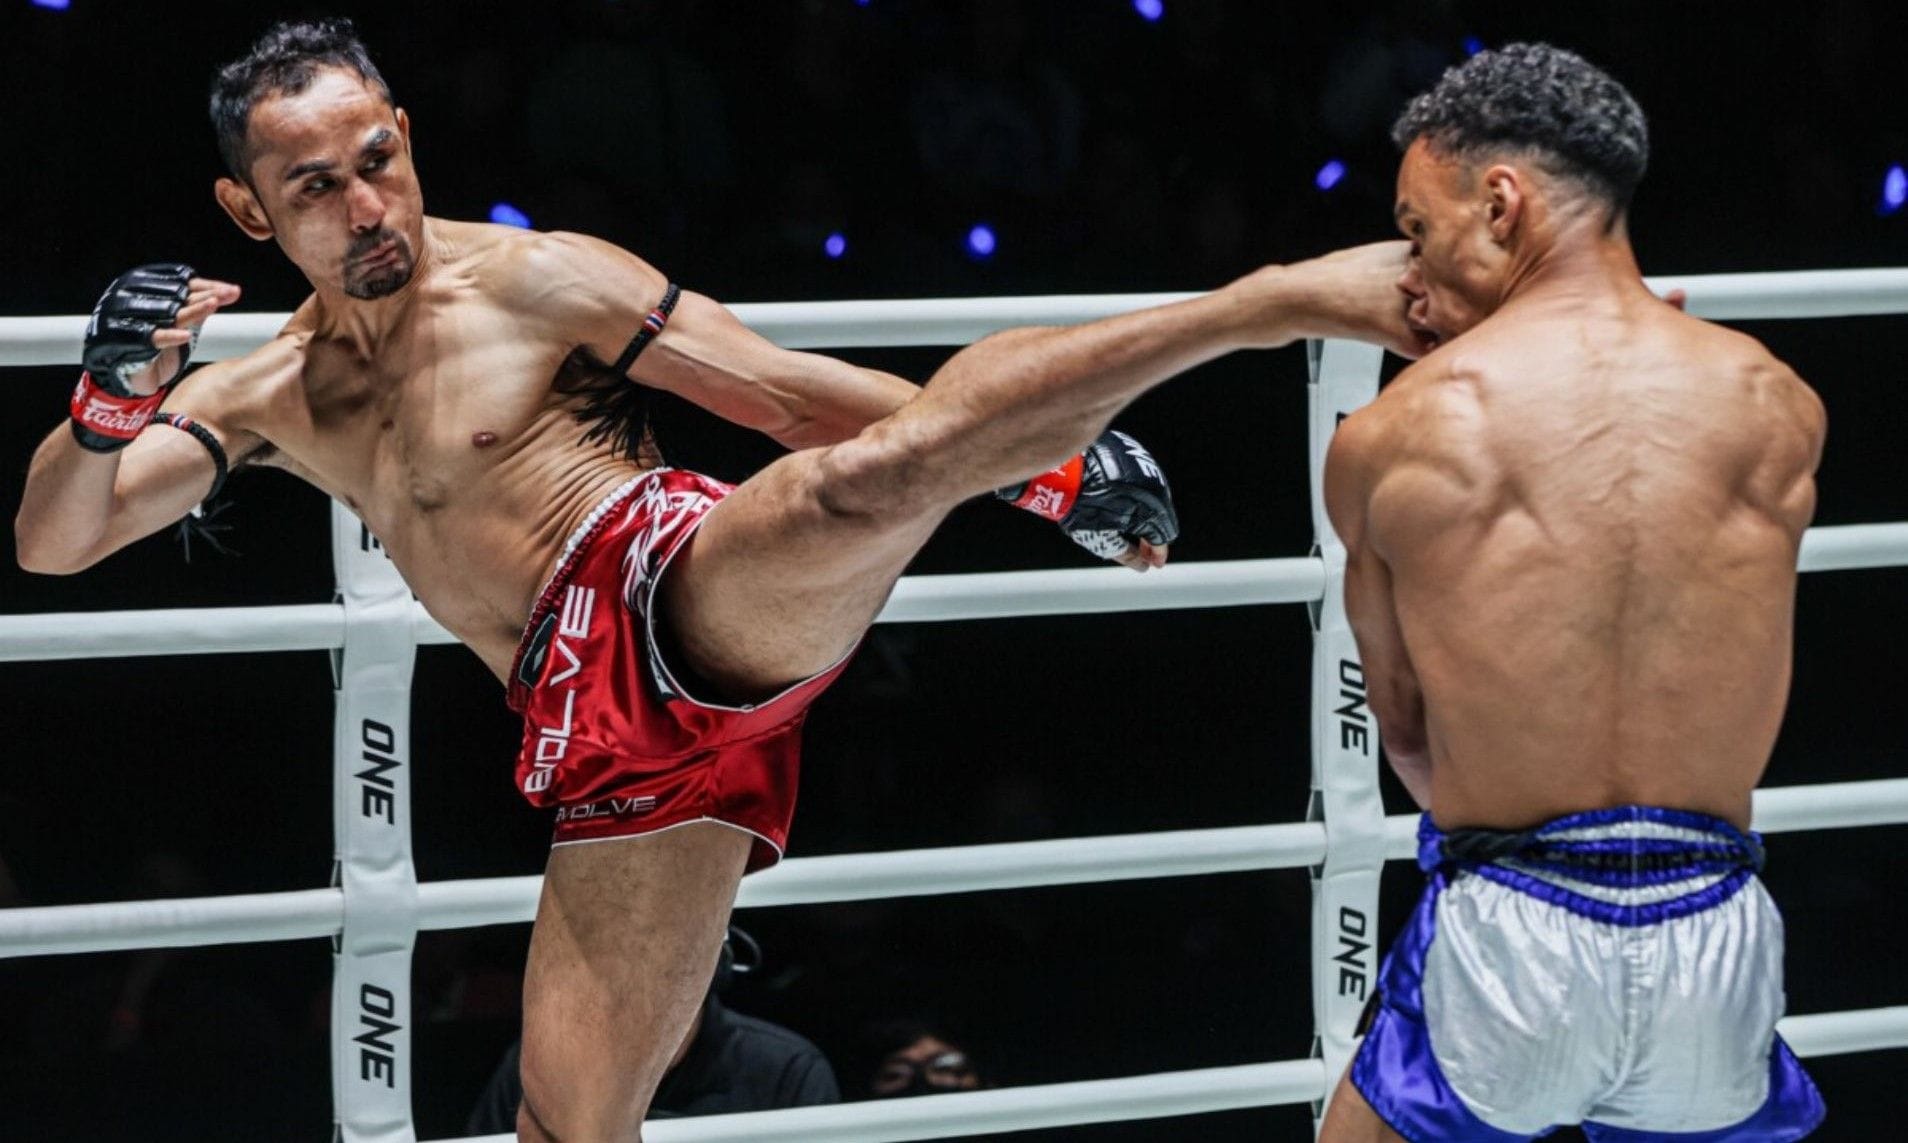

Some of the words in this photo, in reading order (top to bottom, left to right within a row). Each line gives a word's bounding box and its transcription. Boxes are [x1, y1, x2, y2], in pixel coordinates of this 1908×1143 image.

[524, 584, 596, 794] EOLVE
[1333, 658, 1369, 758] ONE
[352, 718, 403, 826] ONE
[1331, 905, 1371, 1003] ONE
[351, 982, 403, 1089] ONE
